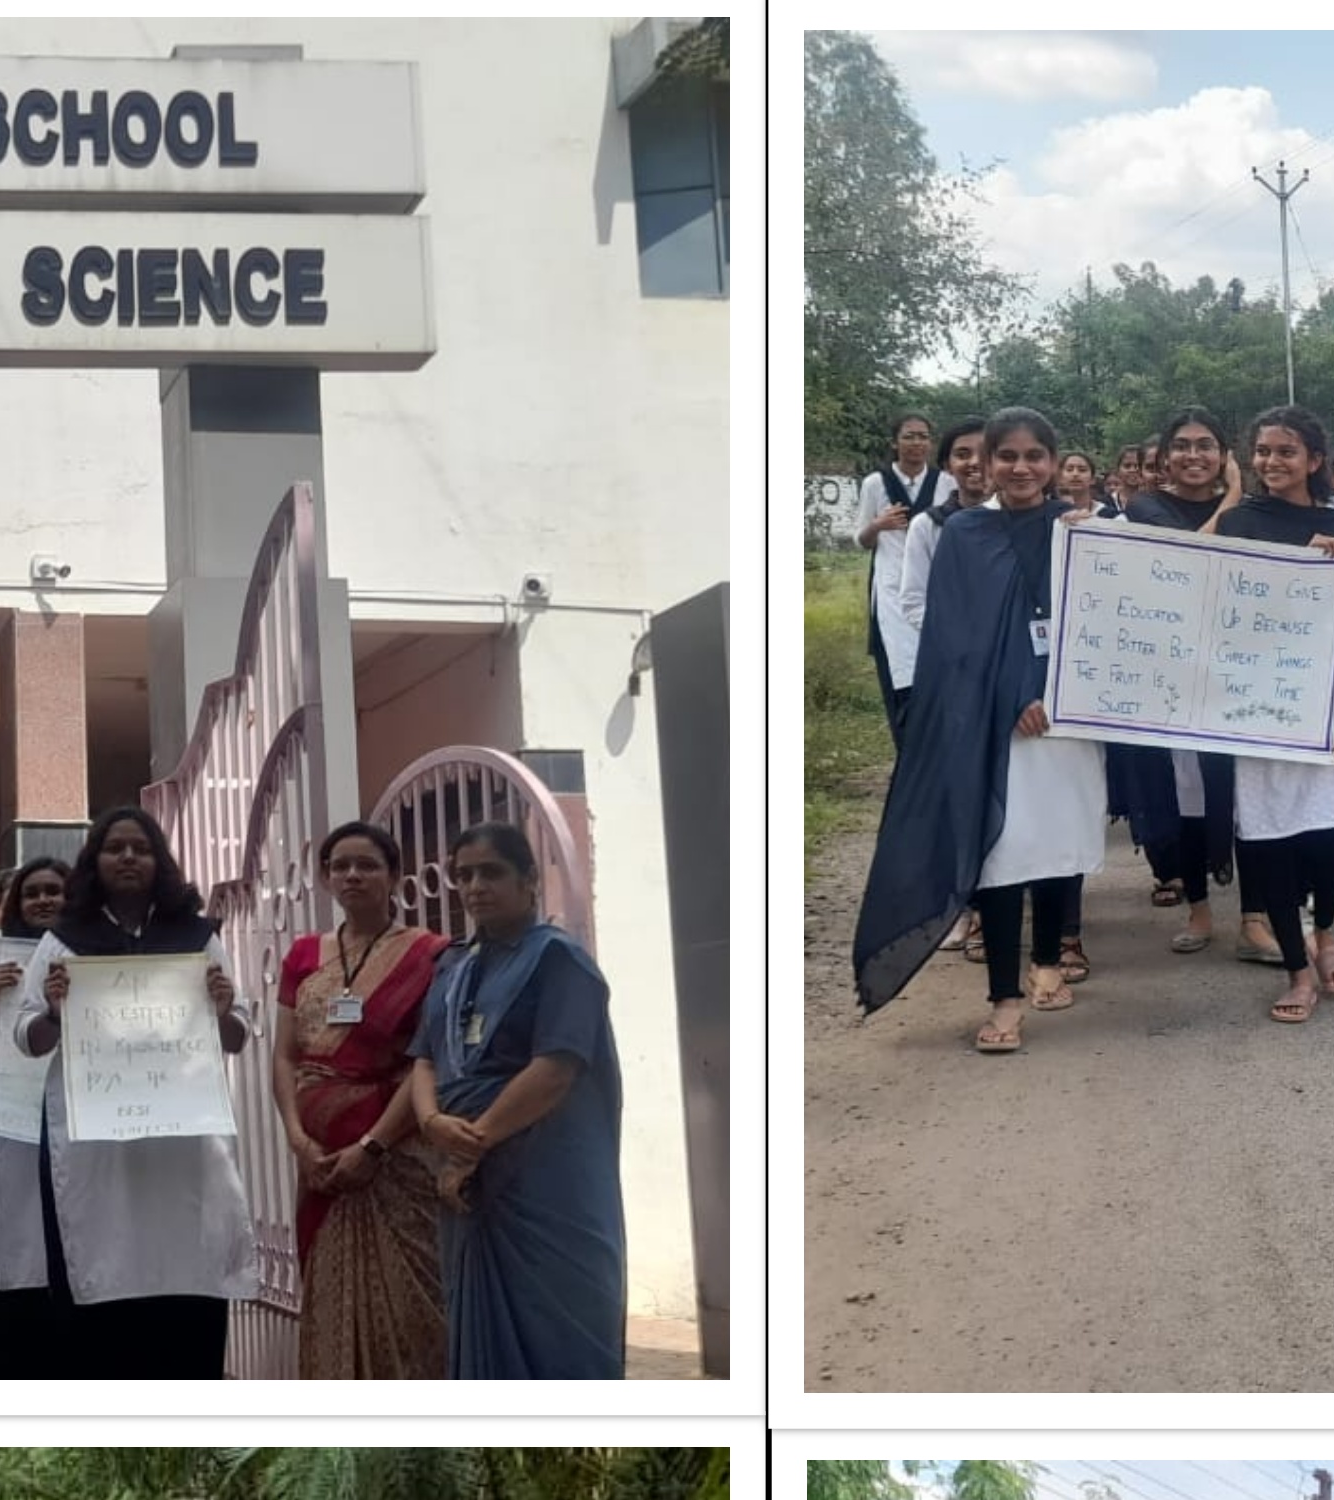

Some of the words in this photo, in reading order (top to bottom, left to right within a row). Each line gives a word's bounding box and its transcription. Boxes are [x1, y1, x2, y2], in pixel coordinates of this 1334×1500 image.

[21, 246, 328, 327] SCIENCE
[1085, 551, 1120, 576] THE
[1151, 560, 1191, 586] ROOTS
[1228, 570, 1269, 597] NEVER
[1286, 578, 1323, 601] GIVE
[1079, 592, 1103, 612] OF
[1222, 607, 1241, 629] UP
[1253, 612, 1313, 635] BECAUSE
[1110, 664, 1143, 684] FRUIT
[1153, 670, 1165, 688] IS
